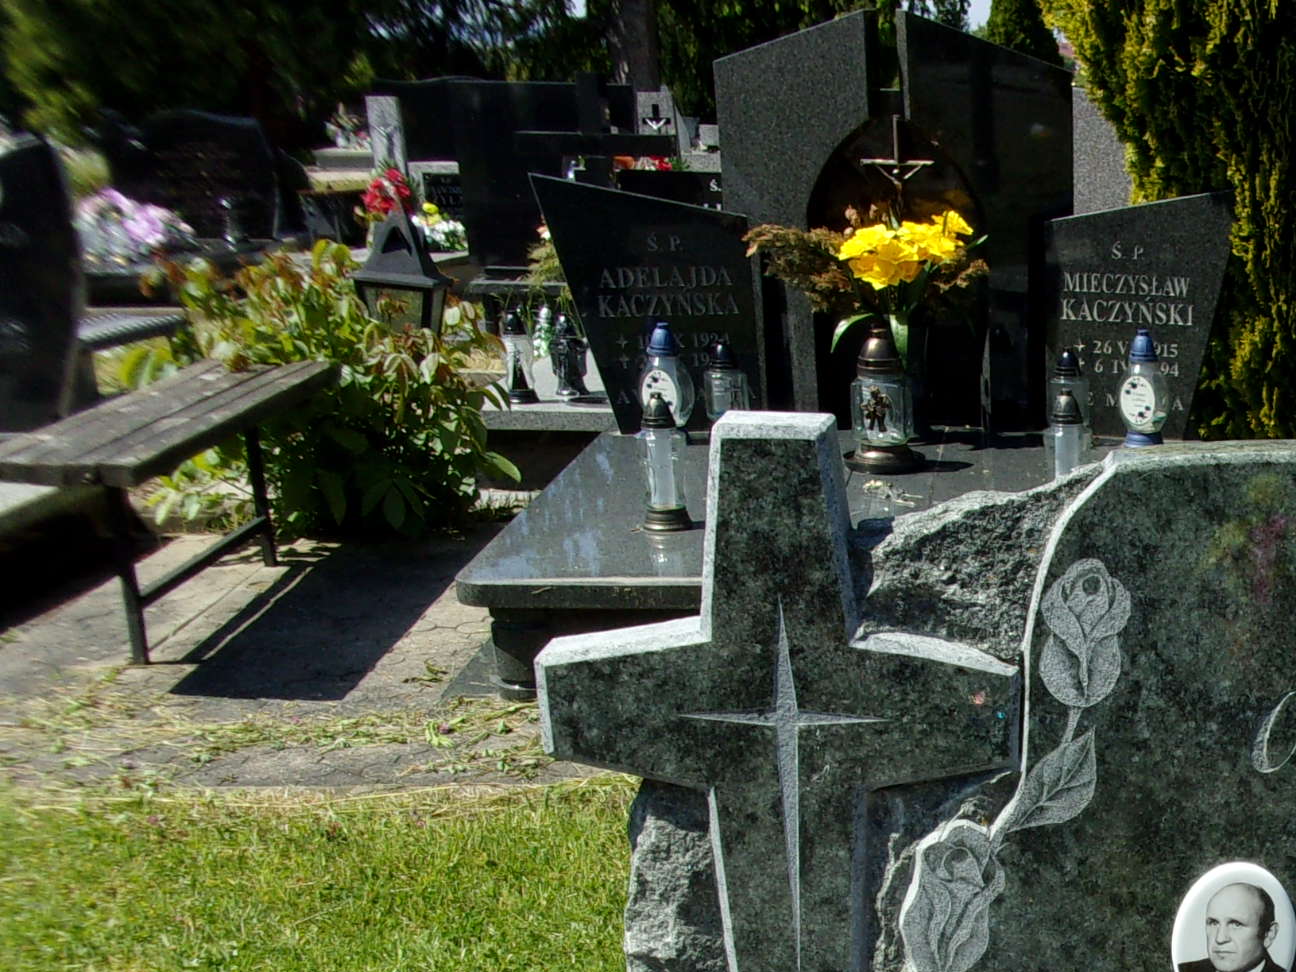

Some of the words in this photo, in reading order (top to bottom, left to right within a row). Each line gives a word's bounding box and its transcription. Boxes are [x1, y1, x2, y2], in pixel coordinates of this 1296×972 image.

[599, 265, 734, 289] ADELAJDA
[1063, 272, 1191, 298] MIECZYSŁAW
[597, 287, 741, 319] KACZYŃSKA
[1060, 296, 1196, 327] KACZYŃSKI
